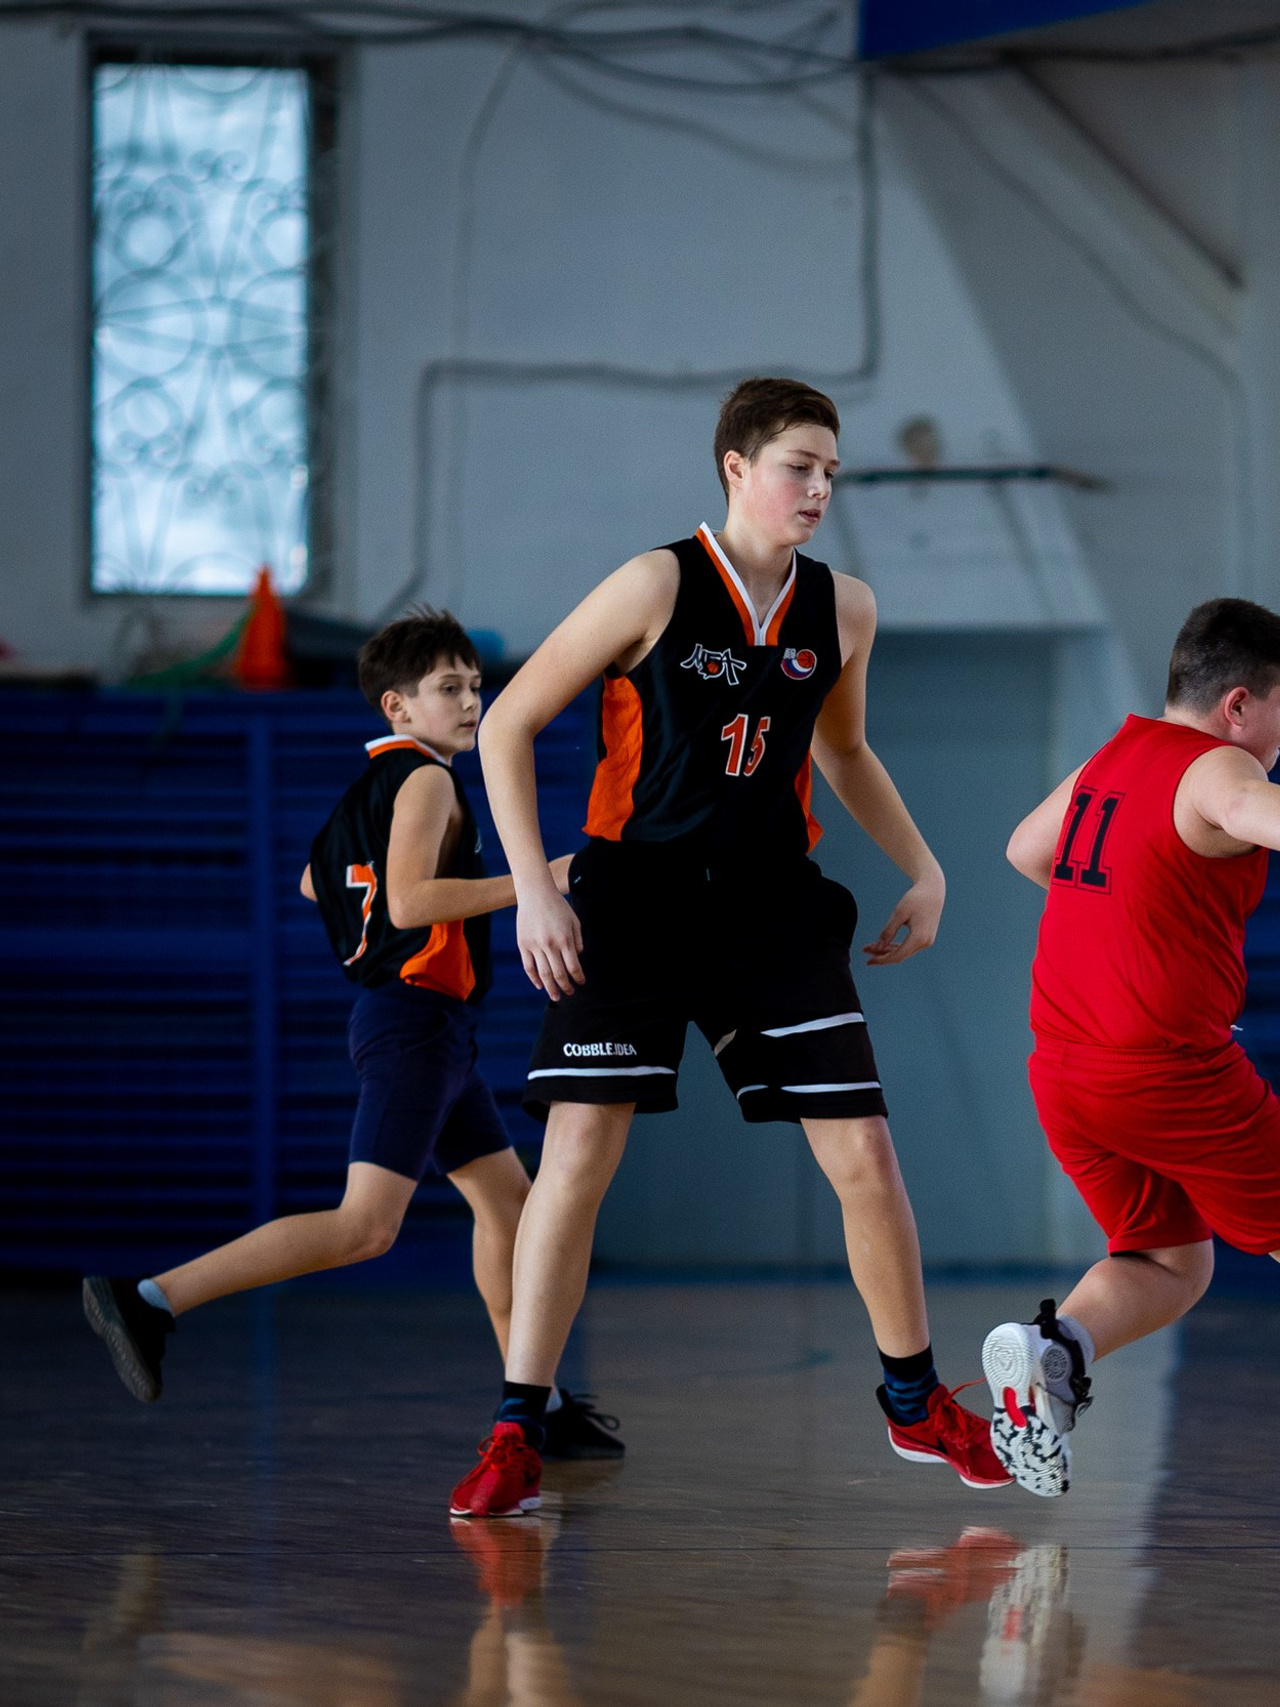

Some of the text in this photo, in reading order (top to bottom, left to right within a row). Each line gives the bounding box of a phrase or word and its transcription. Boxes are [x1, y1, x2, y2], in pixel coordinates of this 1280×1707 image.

[721, 713, 770, 776] 15
[1052, 787, 1124, 894] 11
[343, 861, 378, 966] 7
